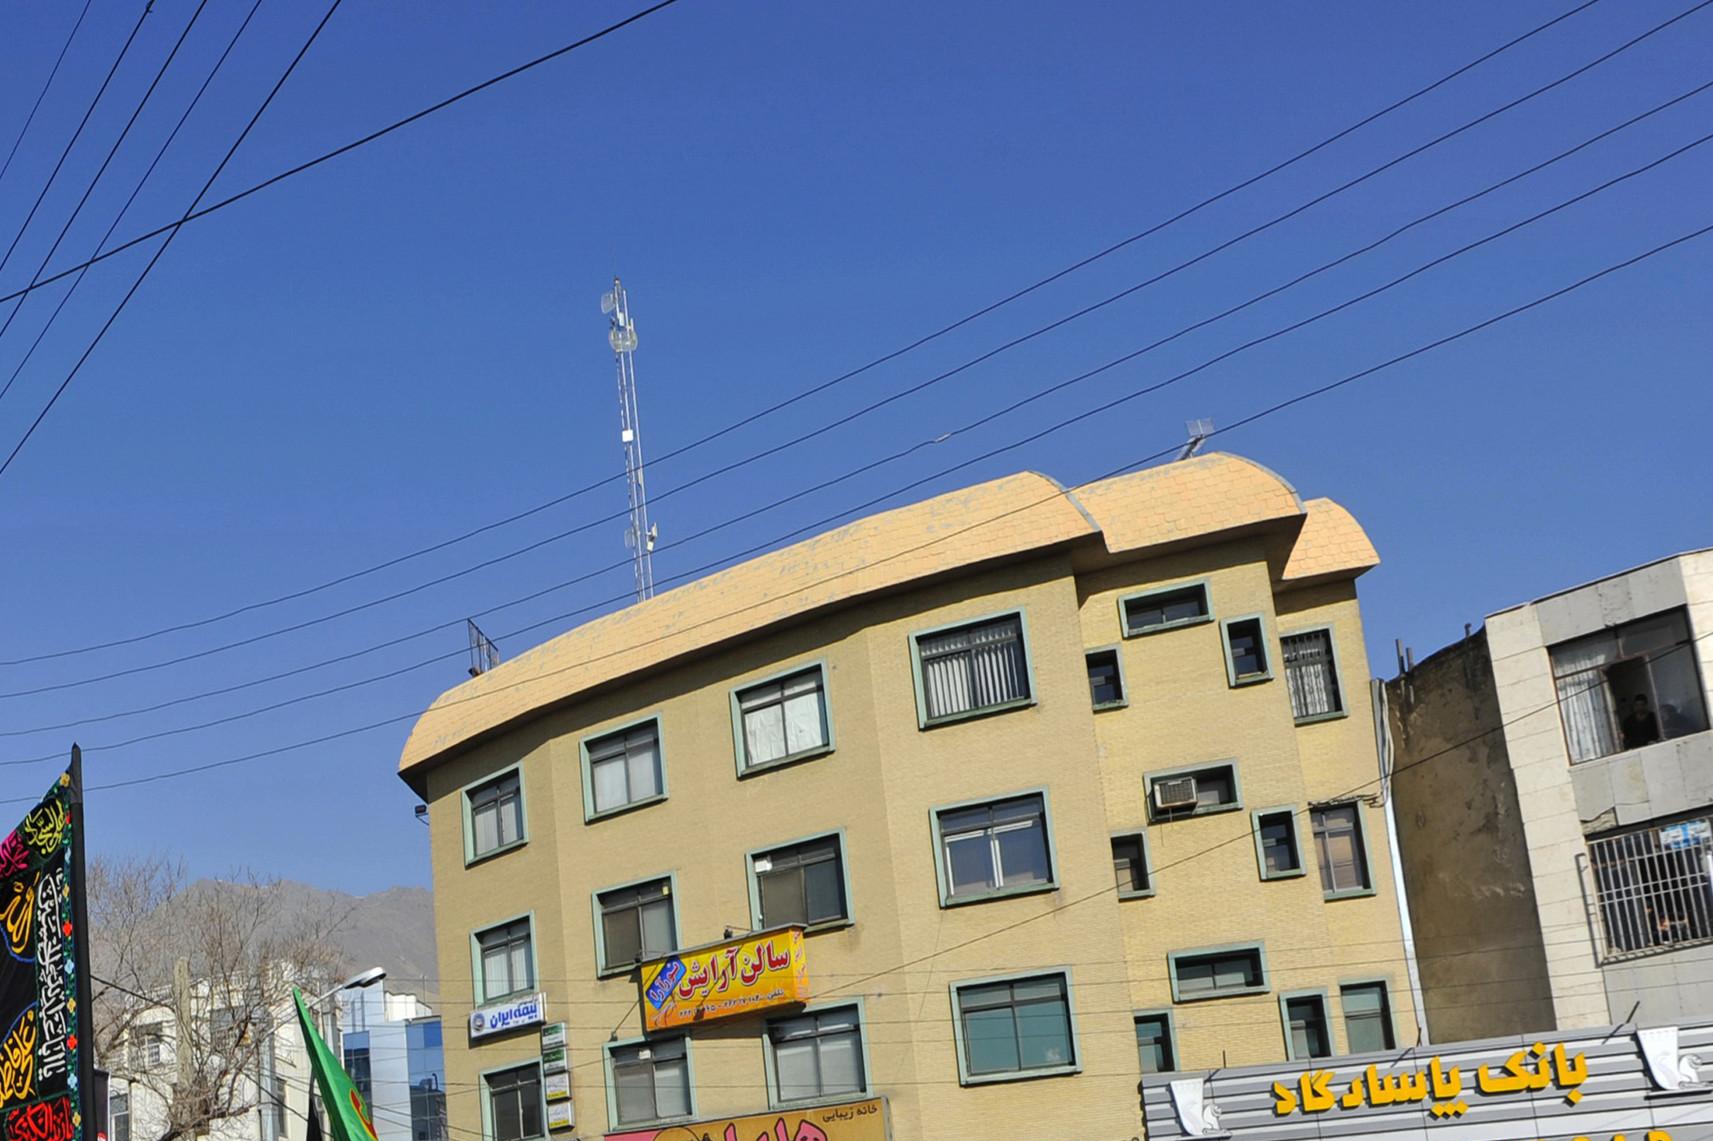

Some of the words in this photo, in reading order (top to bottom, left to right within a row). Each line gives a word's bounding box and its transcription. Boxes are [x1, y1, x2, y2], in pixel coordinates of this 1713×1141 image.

[678, 947, 738, 999] آرایش
[740, 941, 790, 985] سالن
[490, 1009, 513, 1029] ایران
[513, 1000, 538, 1019] بیمه
[1273, 1055, 1469, 1118] پاسارگاد
[1478, 1042, 1588, 1106] بانک
[823, 1107, 854, 1123] زیبایی
[857, 1104, 878, 1117] خانه
